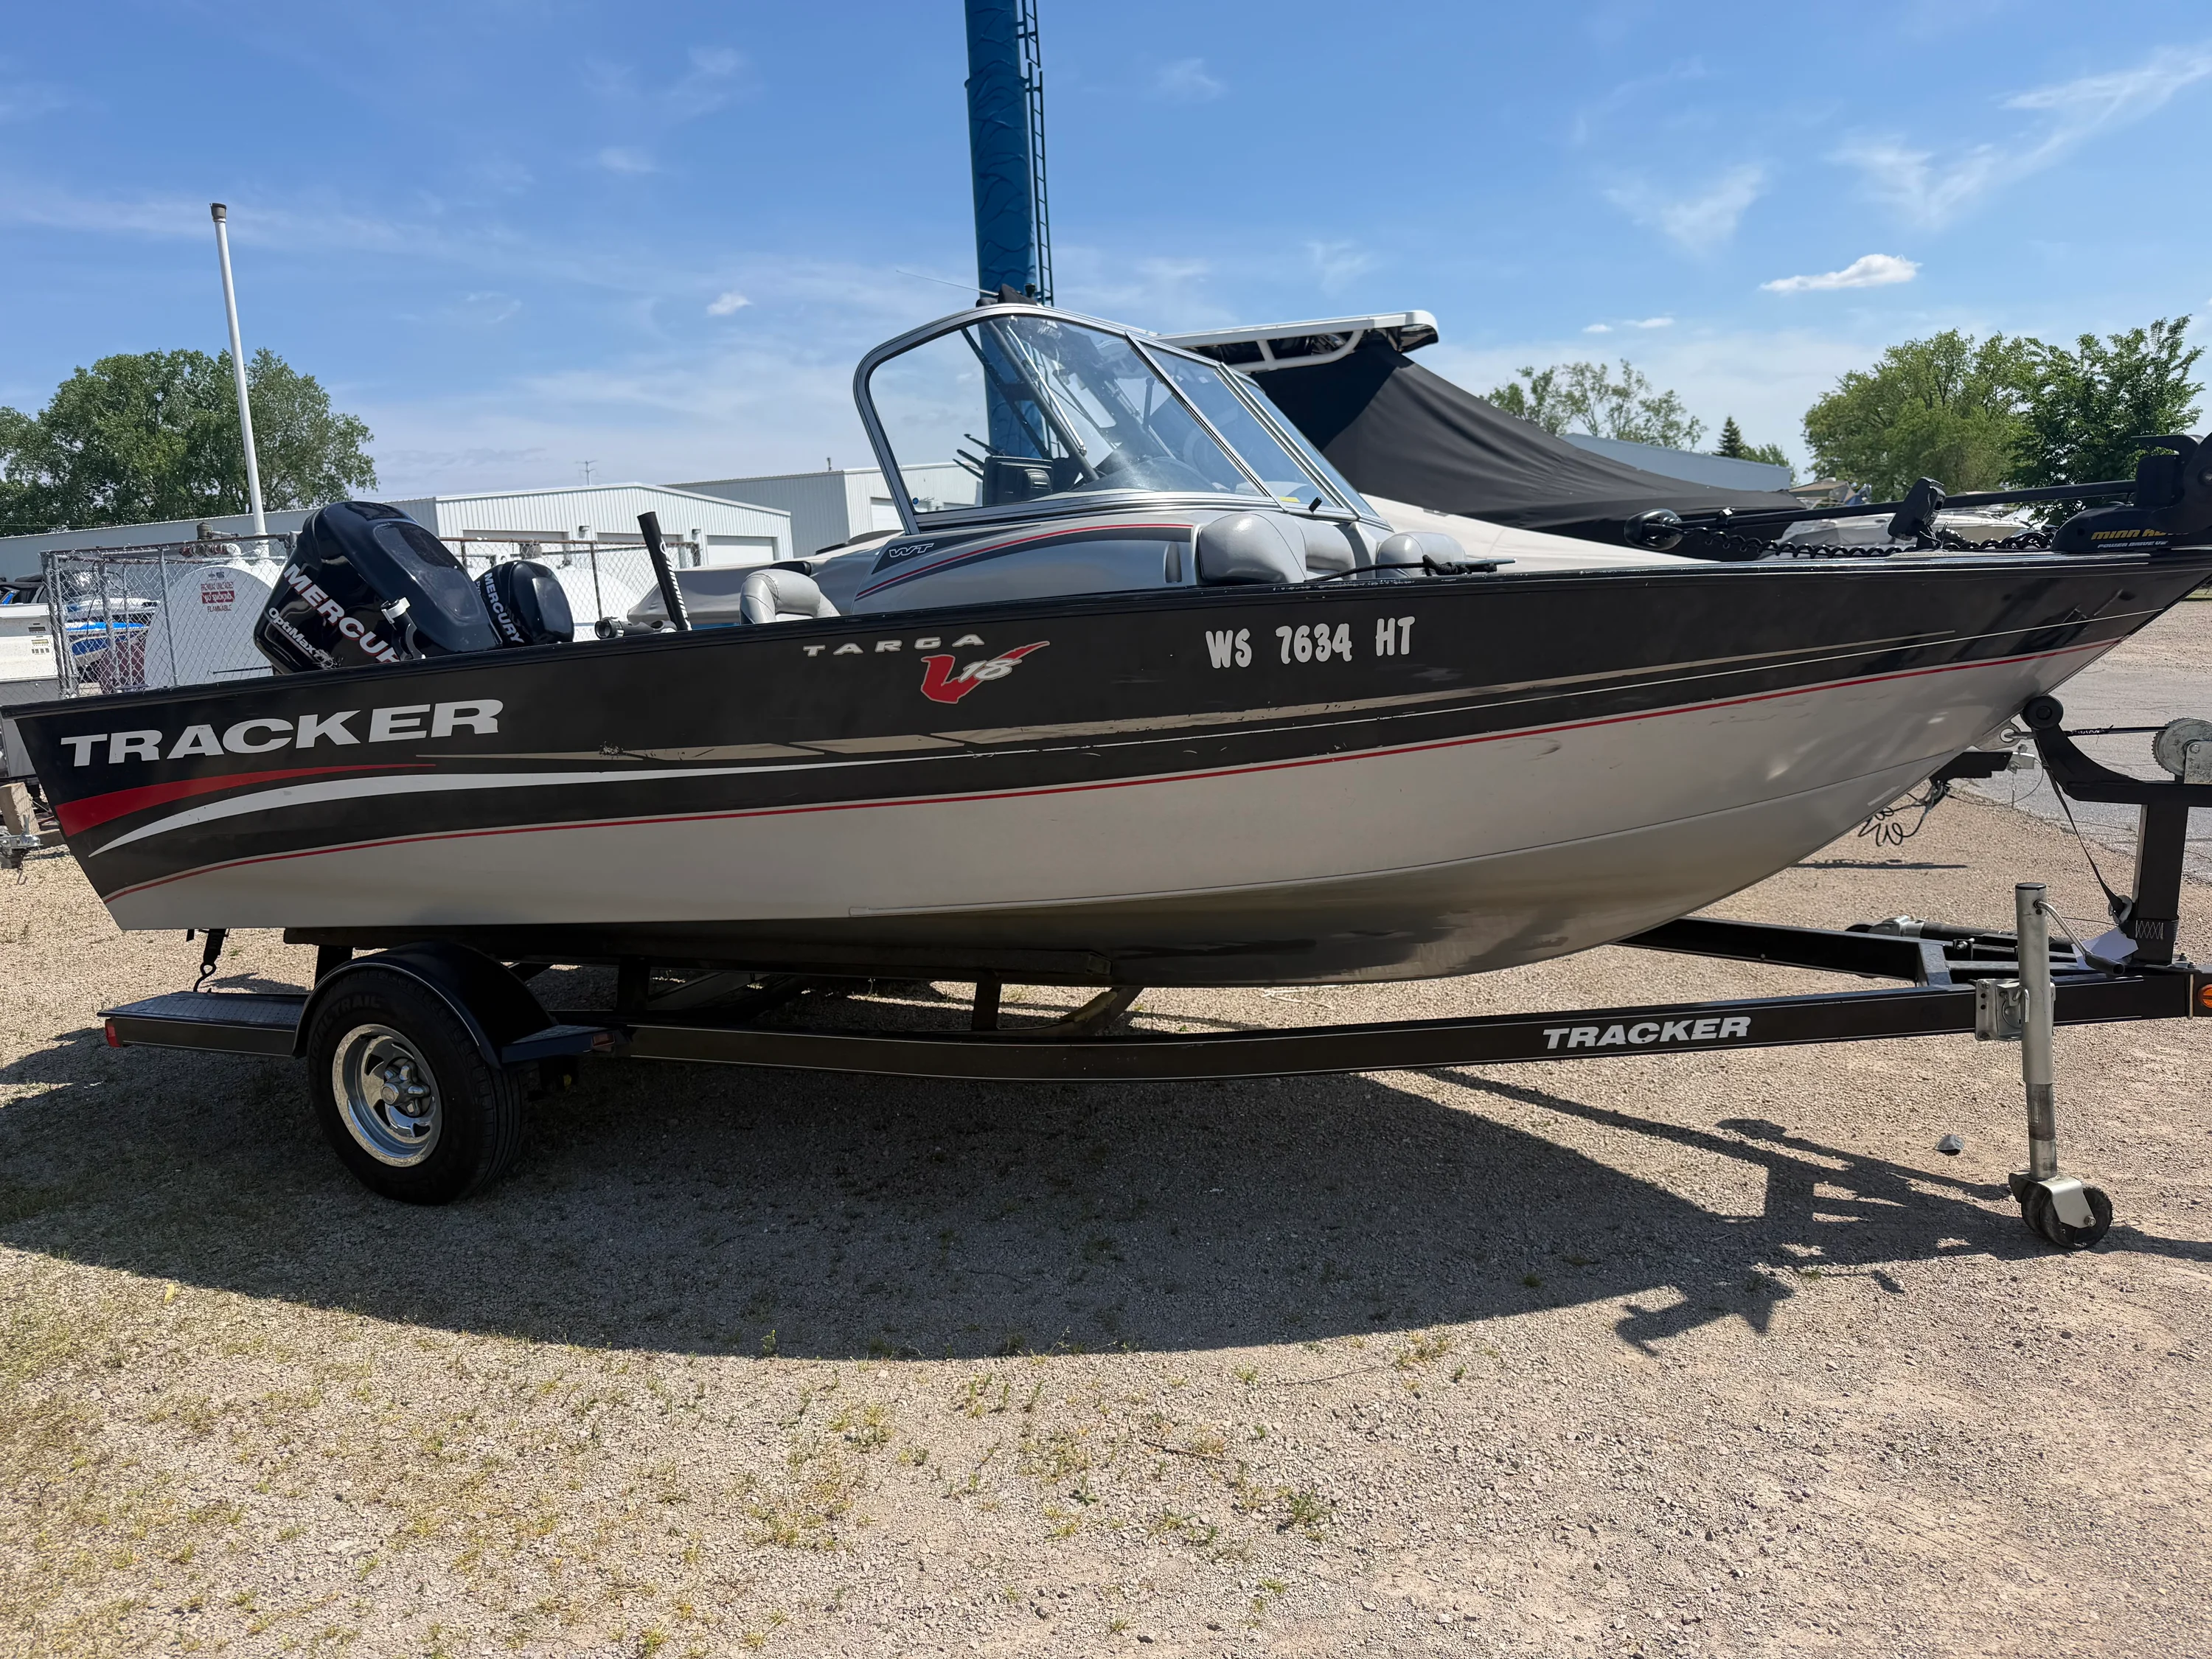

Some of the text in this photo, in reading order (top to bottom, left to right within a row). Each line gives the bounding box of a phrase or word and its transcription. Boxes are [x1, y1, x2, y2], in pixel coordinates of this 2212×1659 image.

[889, 543, 935, 558] WT
[283, 563, 400, 664] MERCUR
[484, 572, 525, 644] MERCURY
[803, 634, 985, 656] TARGA
[1206, 616, 1415, 669] WS 7634 HT
[61, 699, 504, 767] TRACKER
[1543, 1016, 1752, 1049] TRACKER
